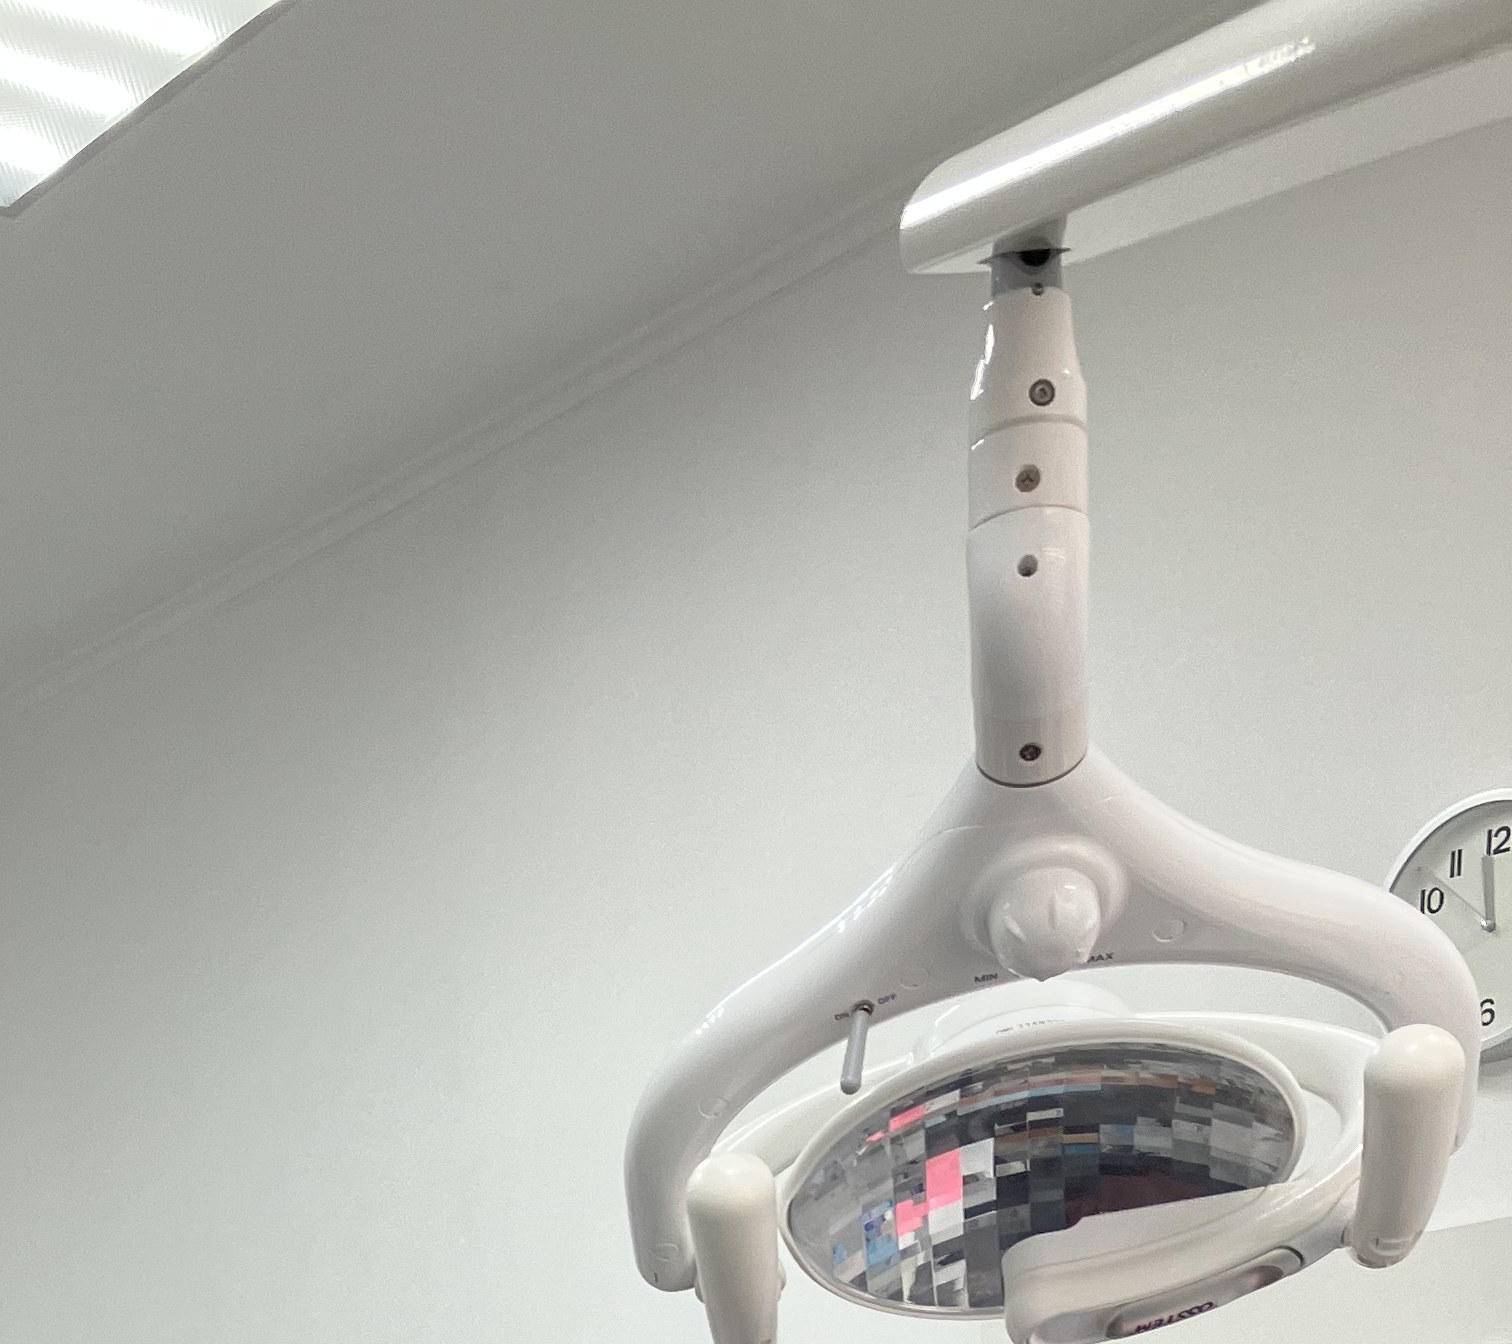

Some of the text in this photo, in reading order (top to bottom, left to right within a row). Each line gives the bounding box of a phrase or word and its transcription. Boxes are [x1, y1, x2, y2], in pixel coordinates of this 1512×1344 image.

[1486, 826, 1511, 856] 12
[1449, 849, 1463, 878] 11
[1419, 887, 1444, 915] 10
[974, 973, 999, 983] MIN
[1480, 999, 1495, 1026] 6
